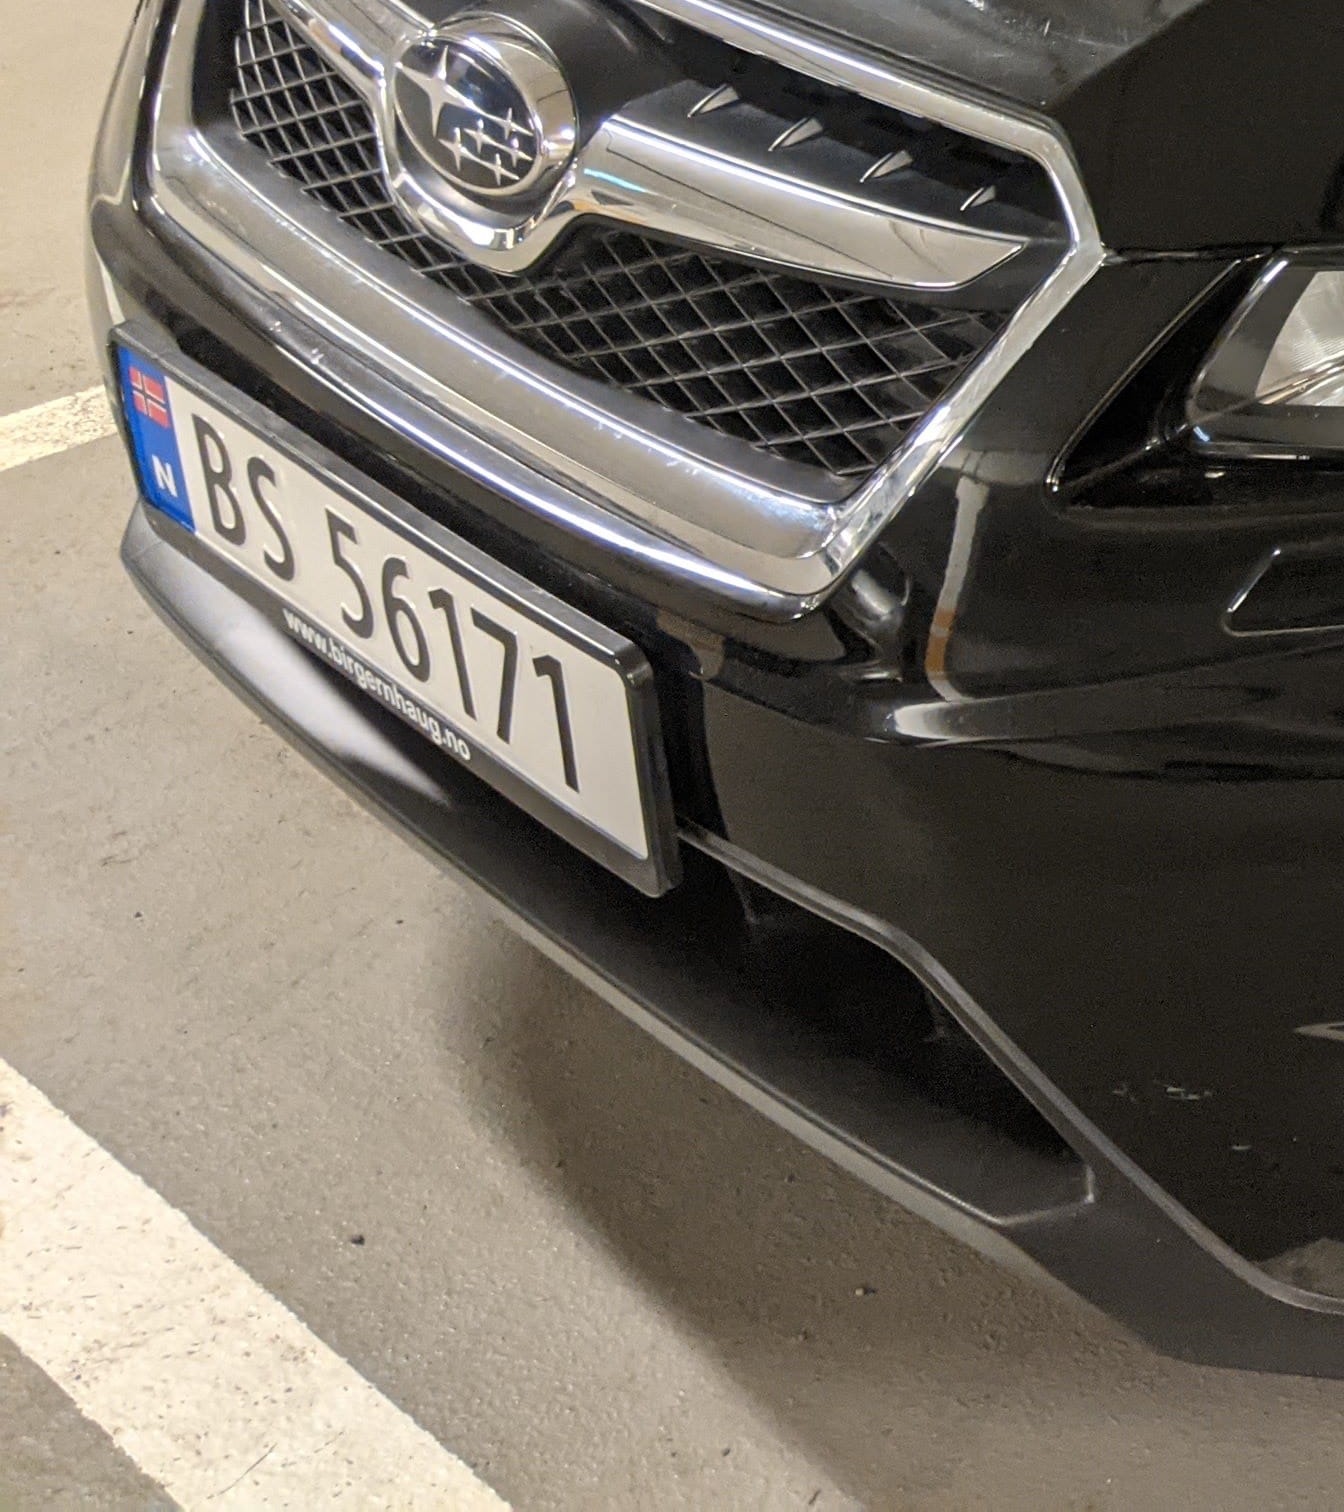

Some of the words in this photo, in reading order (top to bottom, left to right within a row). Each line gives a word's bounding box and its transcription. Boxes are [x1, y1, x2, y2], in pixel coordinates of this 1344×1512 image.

[152, 454, 178, 498] N
[192, 413, 294, 581] BS
[325, 507, 580, 793] 56171
[282, 607, 471, 761] www.birgernhaug.no
